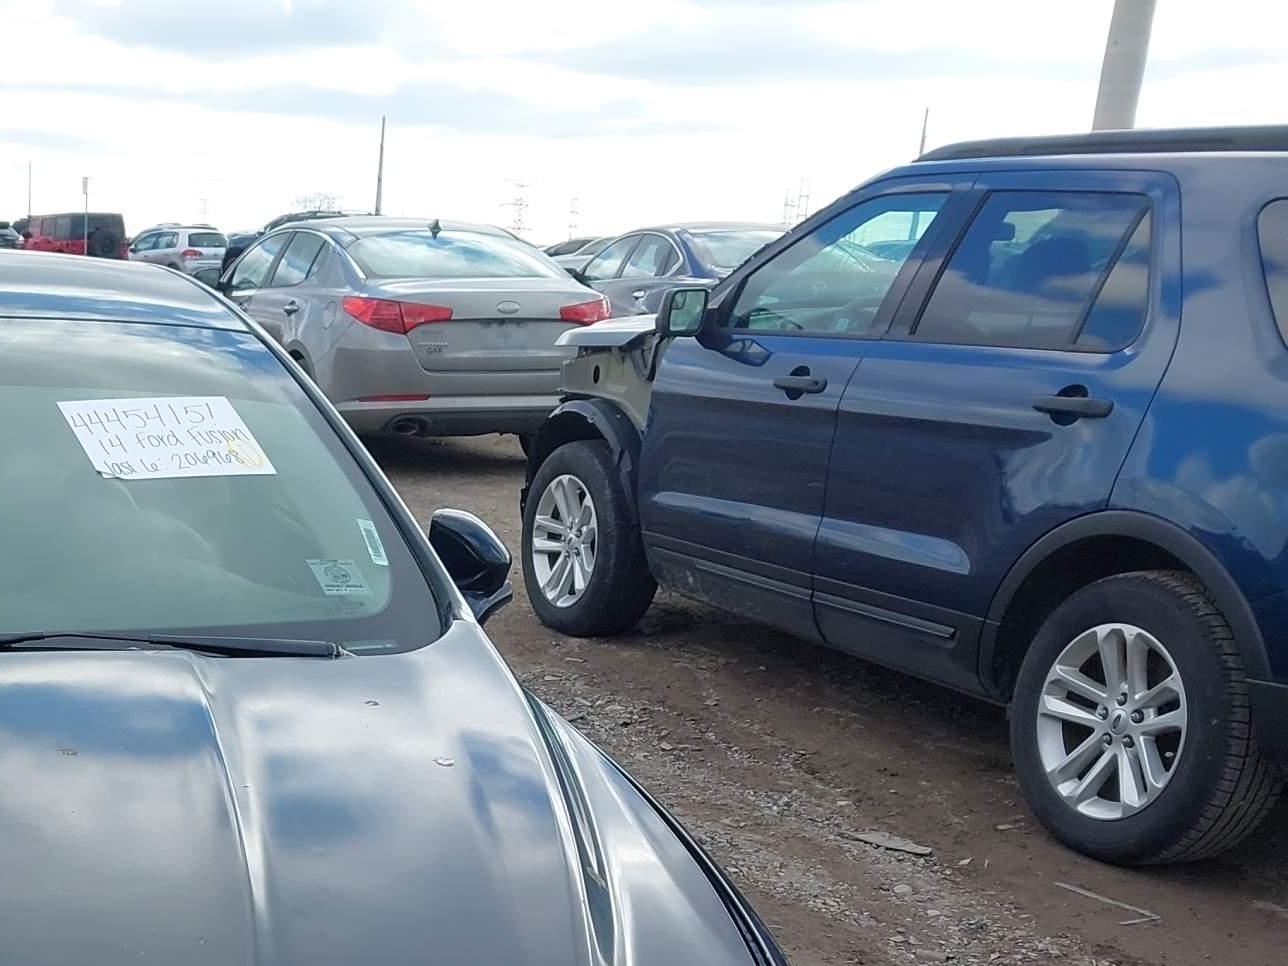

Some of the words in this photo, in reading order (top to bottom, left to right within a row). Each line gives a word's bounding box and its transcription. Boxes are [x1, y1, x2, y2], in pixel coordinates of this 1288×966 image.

[70, 403, 214, 435] 44454151
[98, 435, 128, 455] 14
[136, 430, 185, 449] Ford
[187, 426, 249, 446] Fusion
